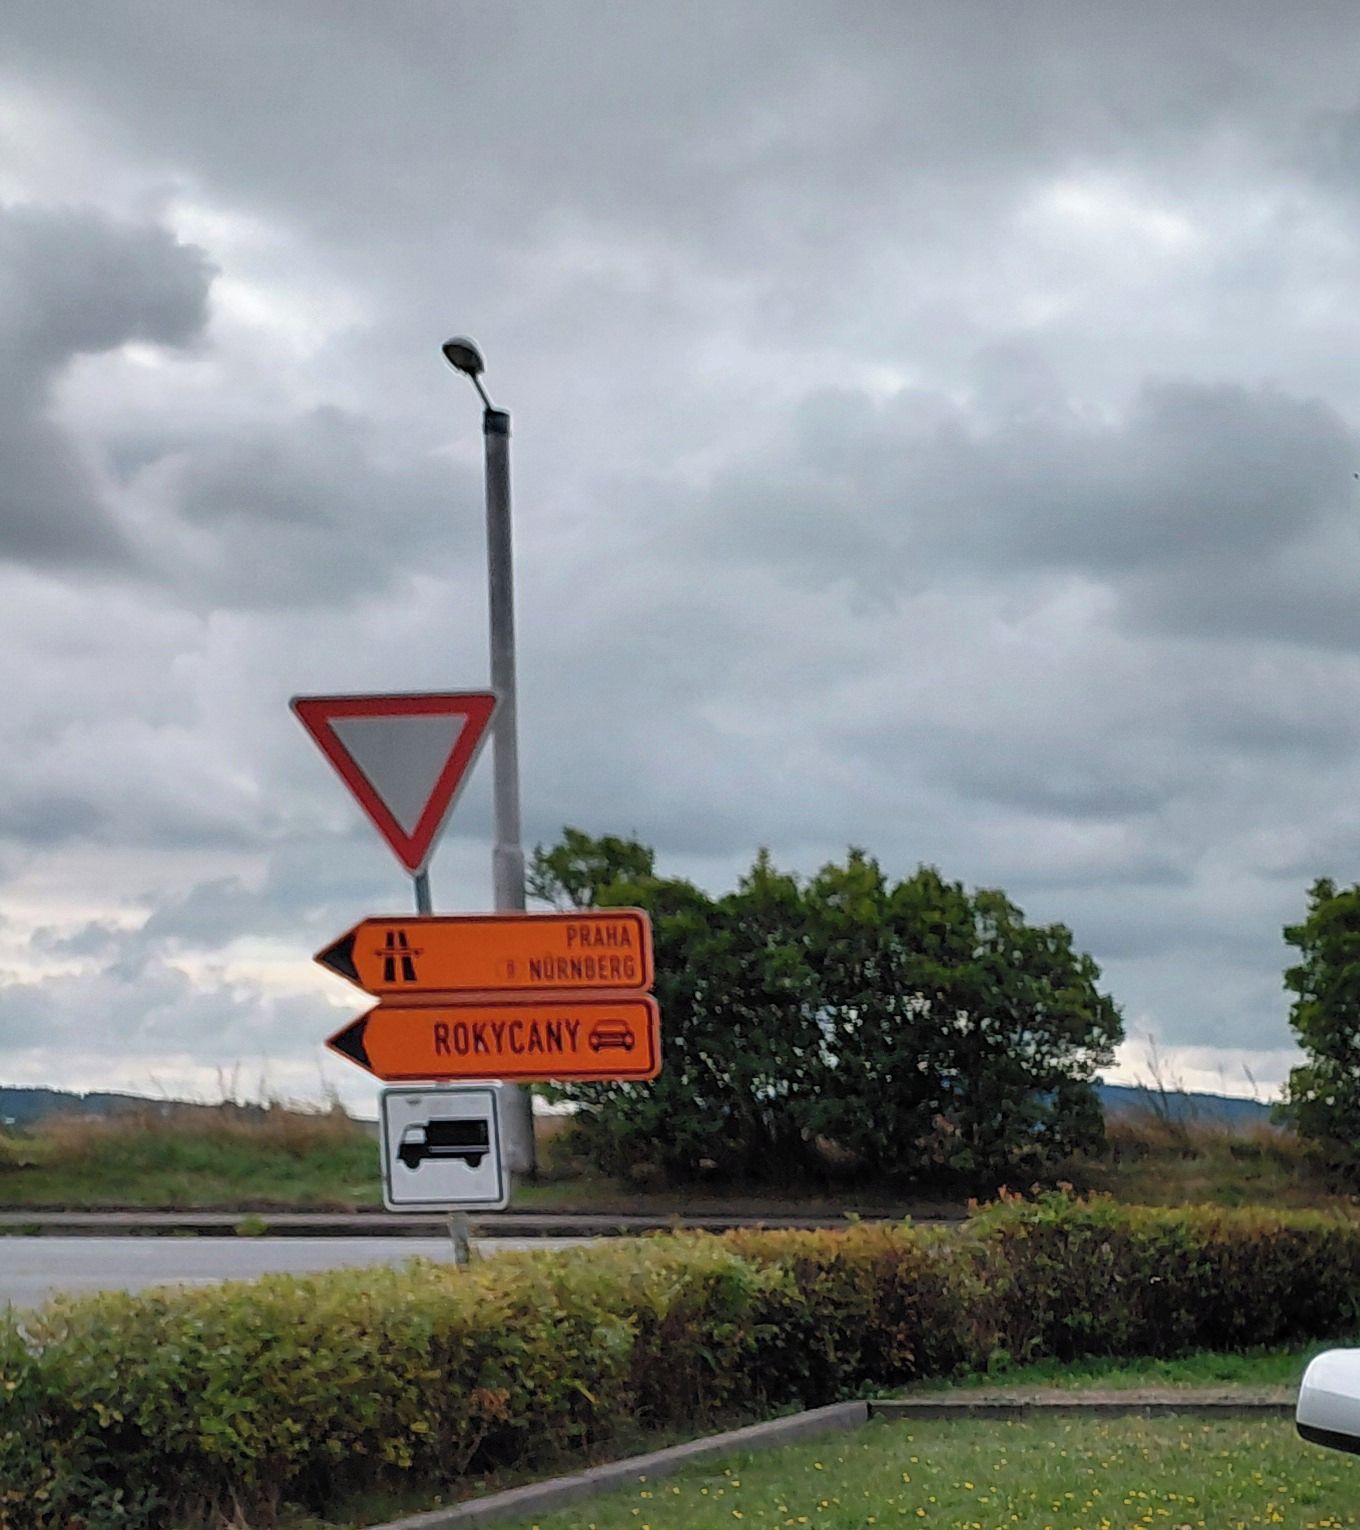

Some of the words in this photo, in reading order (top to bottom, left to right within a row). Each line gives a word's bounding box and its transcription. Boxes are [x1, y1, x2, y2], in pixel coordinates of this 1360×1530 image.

[566, 923, 633, 949] PRAHA
[529, 951, 636, 980] NÜRNBERG
[433, 1018, 581, 1057] ROKYCANY
